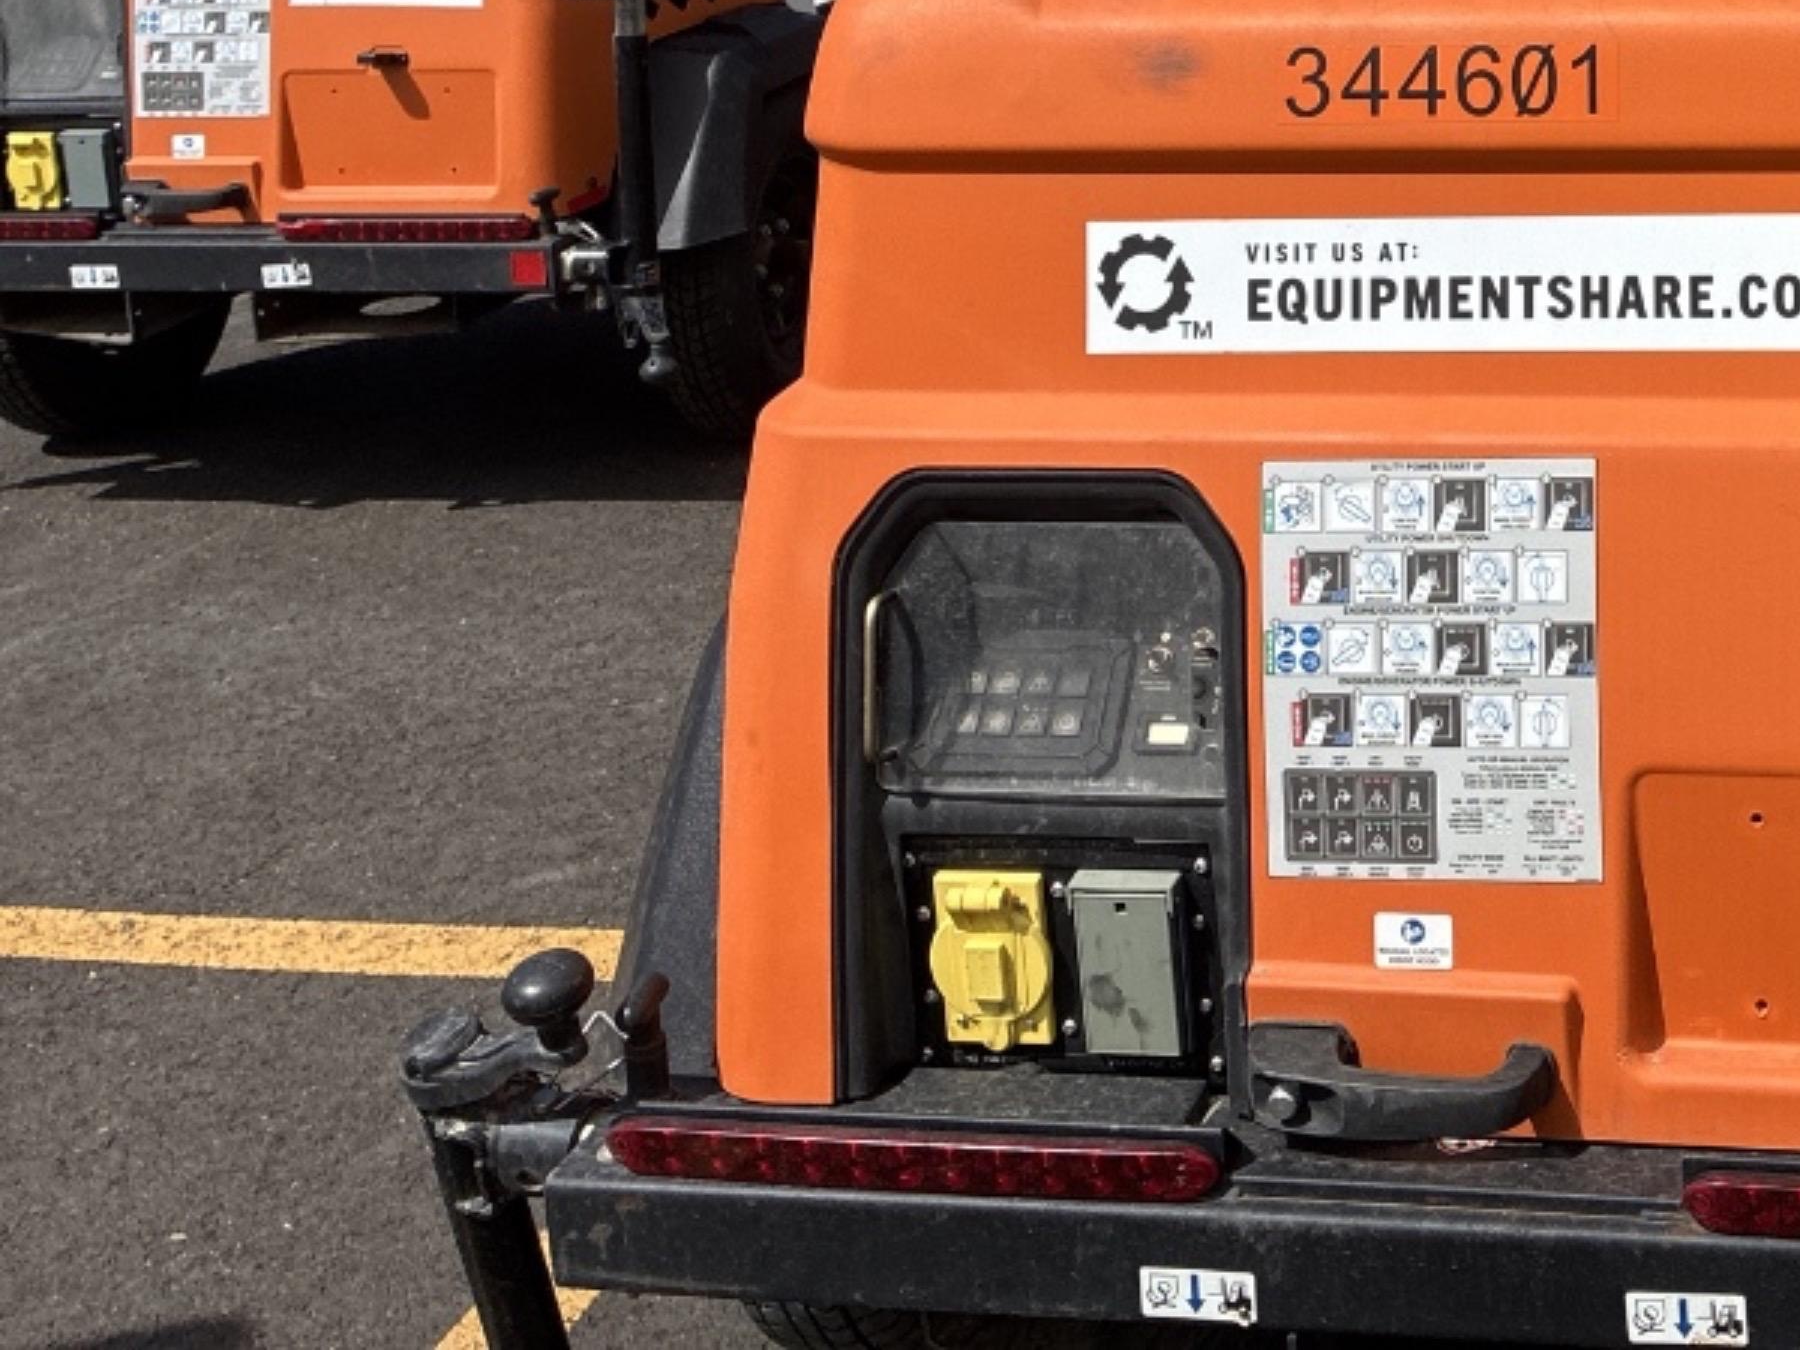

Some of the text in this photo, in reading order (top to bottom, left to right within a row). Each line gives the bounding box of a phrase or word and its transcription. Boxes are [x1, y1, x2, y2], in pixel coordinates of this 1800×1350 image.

[1286, 43, 1598, 118] 344601
[1245, 241, 1420, 263] VISIT US AT:
[1178, 320, 1213, 340] TM
